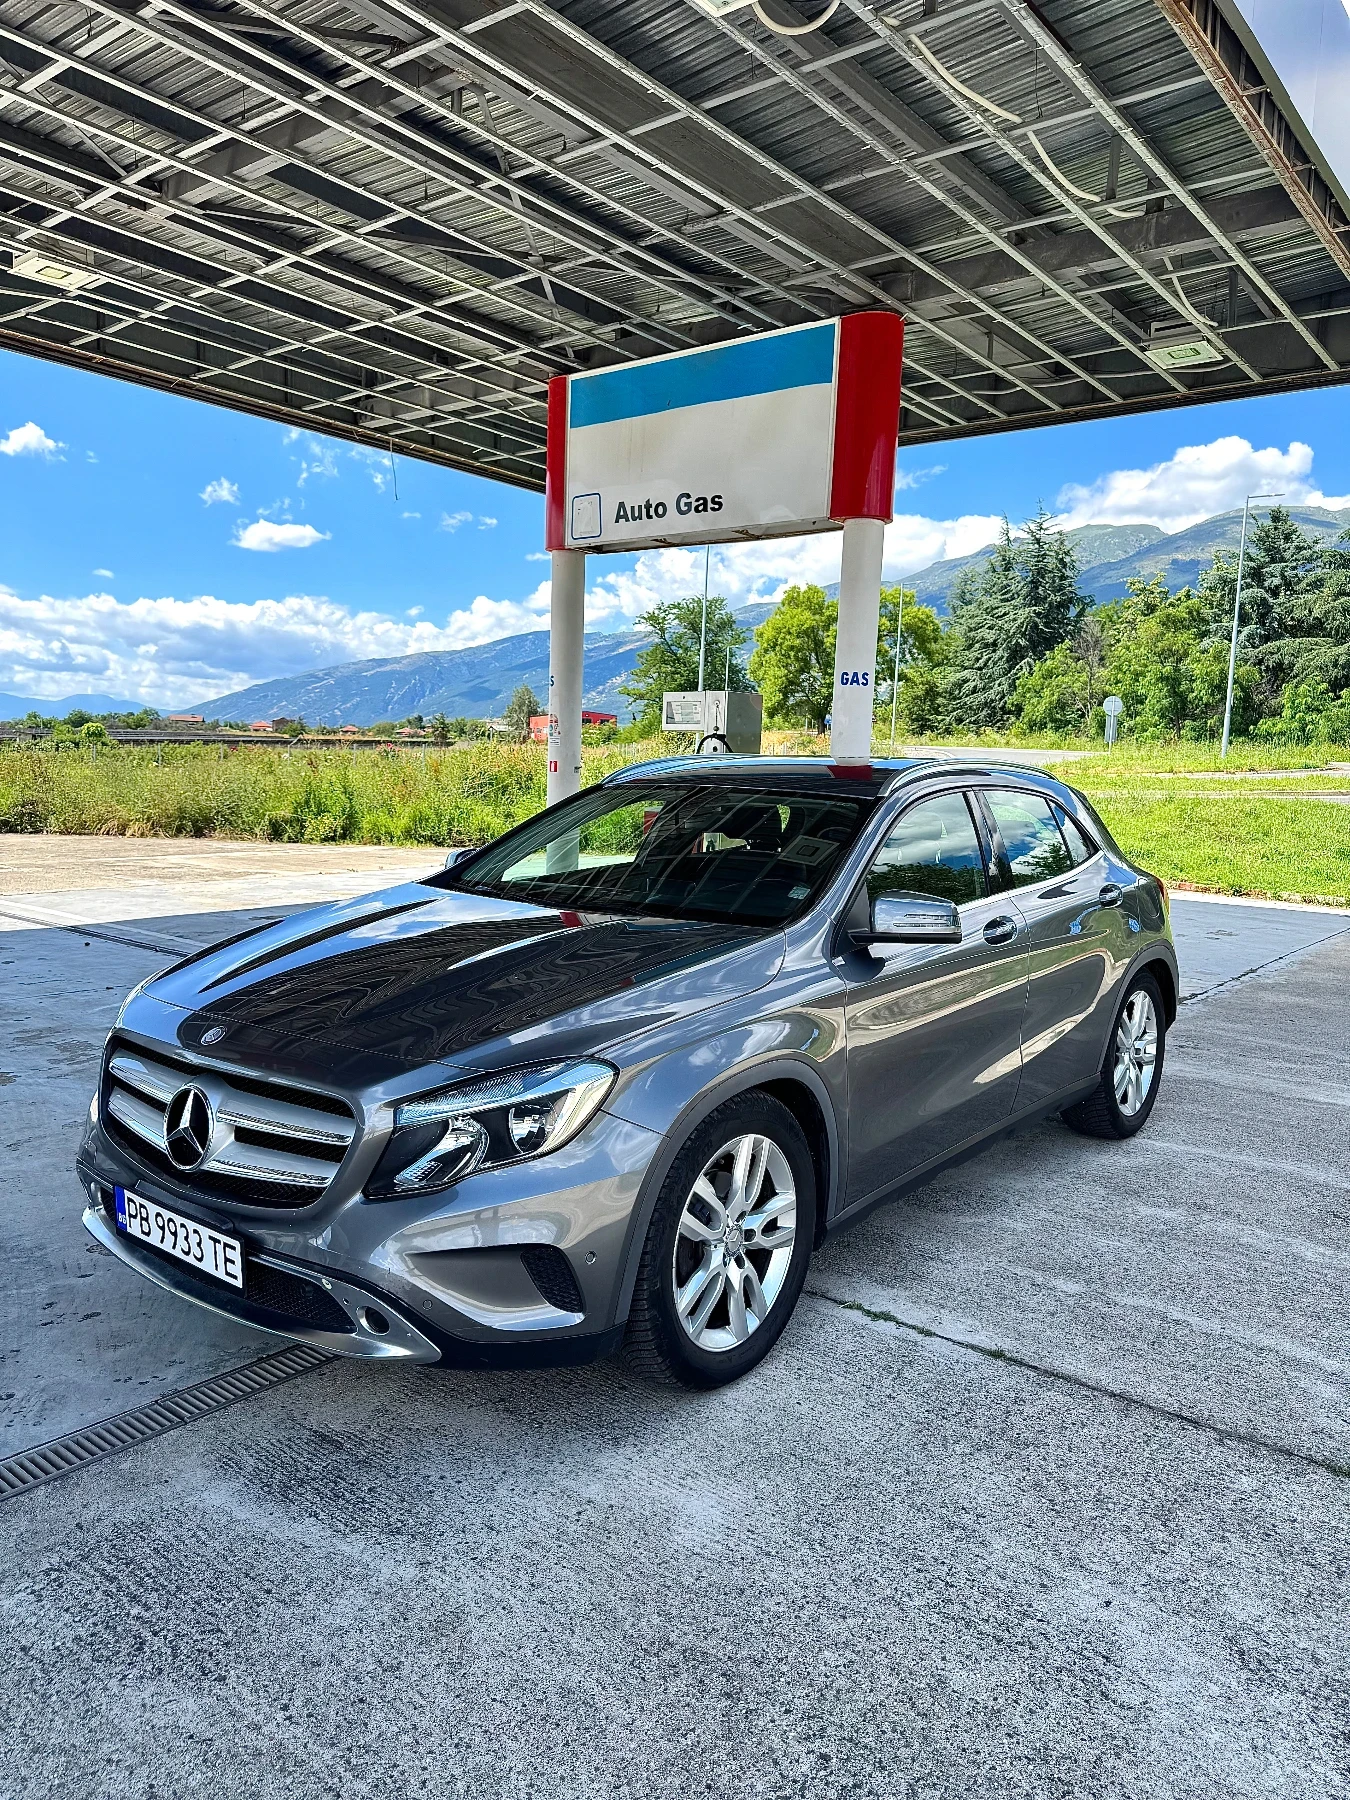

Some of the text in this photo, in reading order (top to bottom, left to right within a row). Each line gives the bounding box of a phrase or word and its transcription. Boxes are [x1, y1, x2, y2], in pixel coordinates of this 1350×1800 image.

[614, 492, 724, 524] Auto Gas
[840, 671, 869, 687] GAS
[126, 1195, 239, 1282] PB 9933 TE
